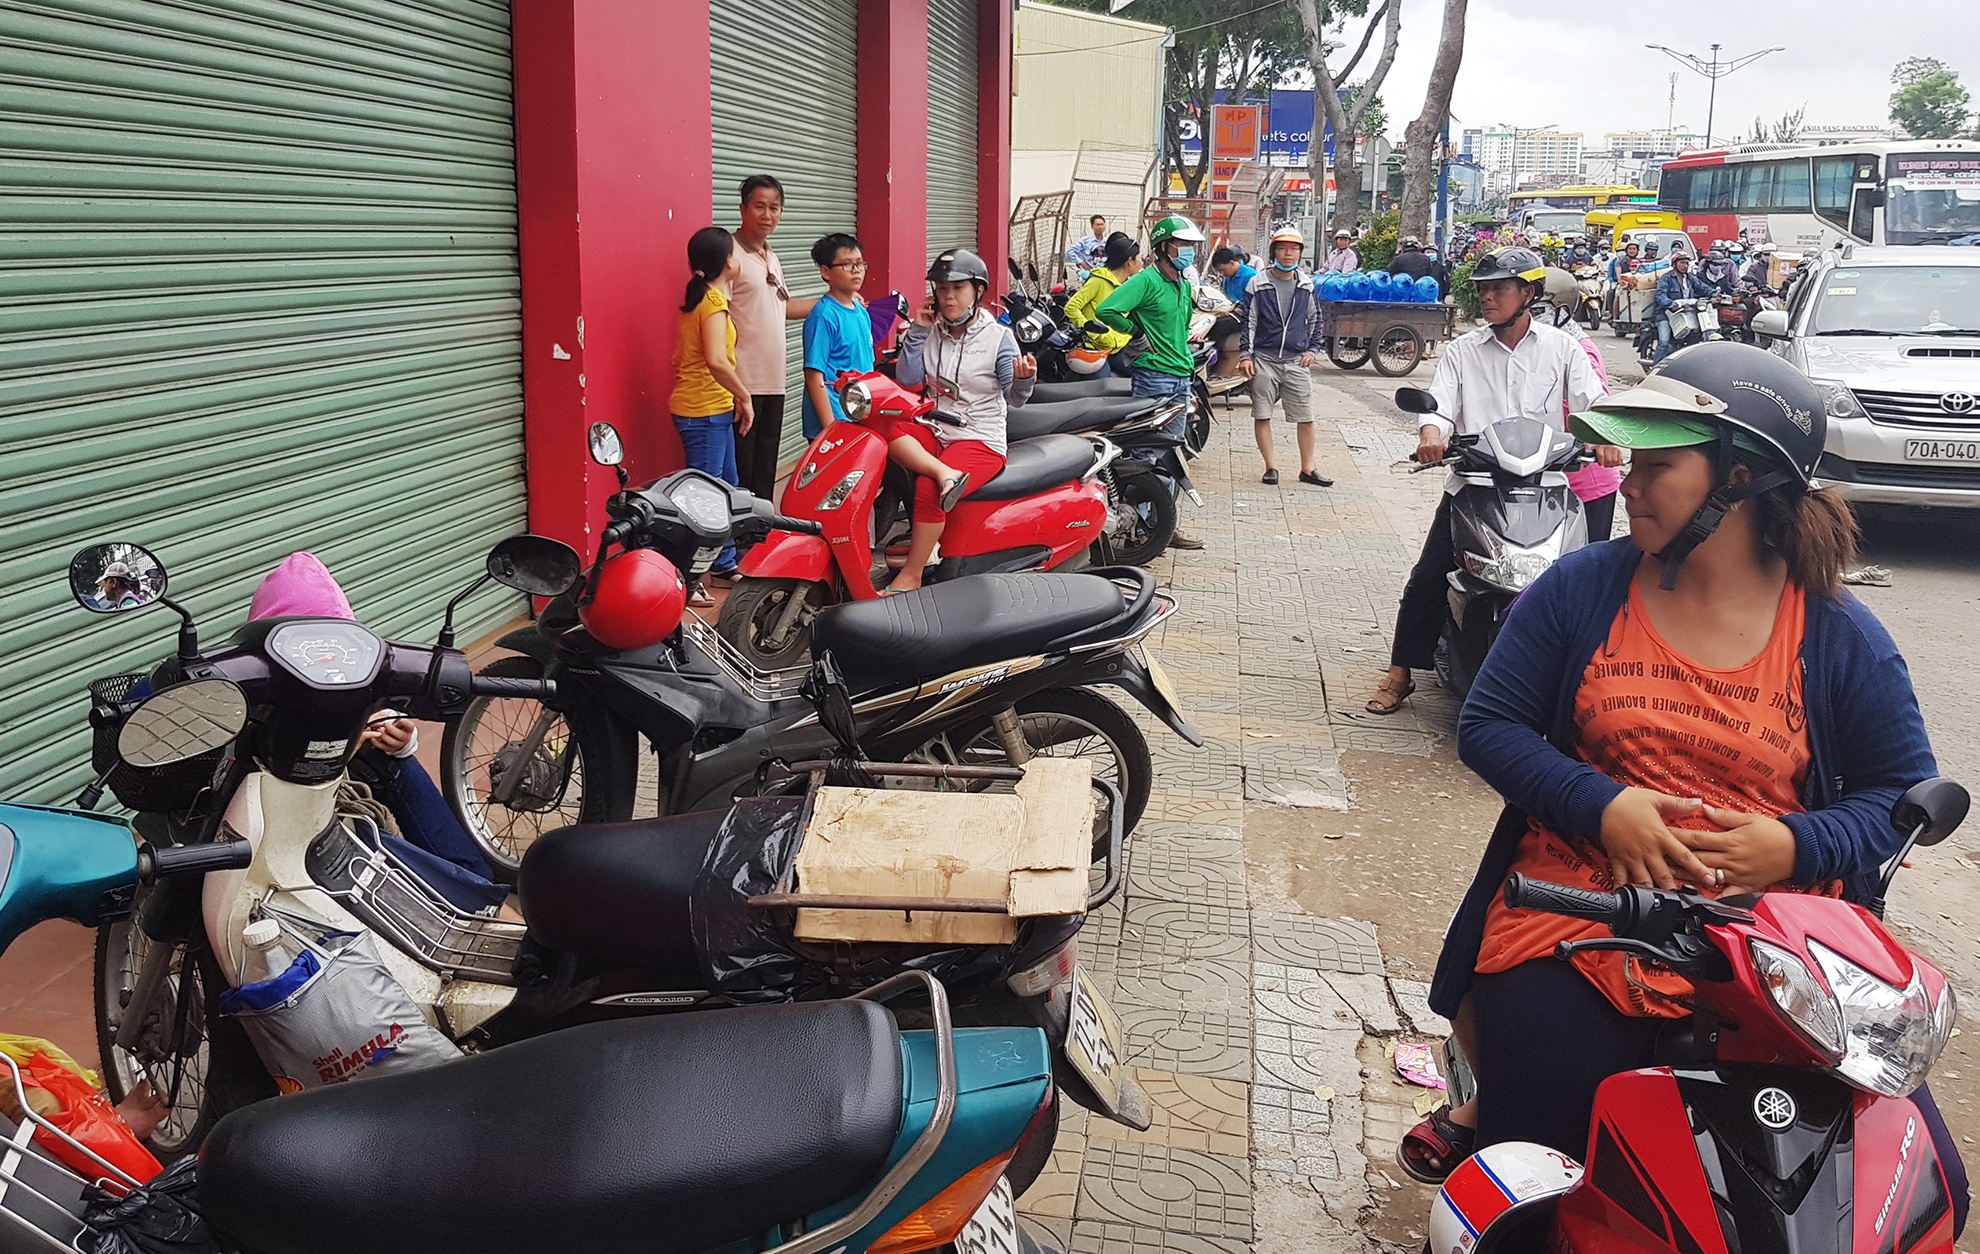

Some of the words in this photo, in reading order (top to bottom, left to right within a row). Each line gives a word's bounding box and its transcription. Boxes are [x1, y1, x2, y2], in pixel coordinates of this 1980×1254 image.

[1760, 386, 1775, 397] safe
[1775, 393, 1793, 417] driving
[1601, 695, 1647, 712] BAOMIER
[1704, 678, 1760, 703] BAOMIER
[1652, 697, 1701, 718] BAOMIER
[1701, 706, 1751, 734] BAOMIER
[1697, 736, 1741, 762] BAOMIER
[313, 1047, 343, 1069] Shell
[319, 1022, 404, 1082] RIMULA
[1874, 1160, 1904, 1236] SIRIUS
[1900, 1116, 1916, 1160] RC
